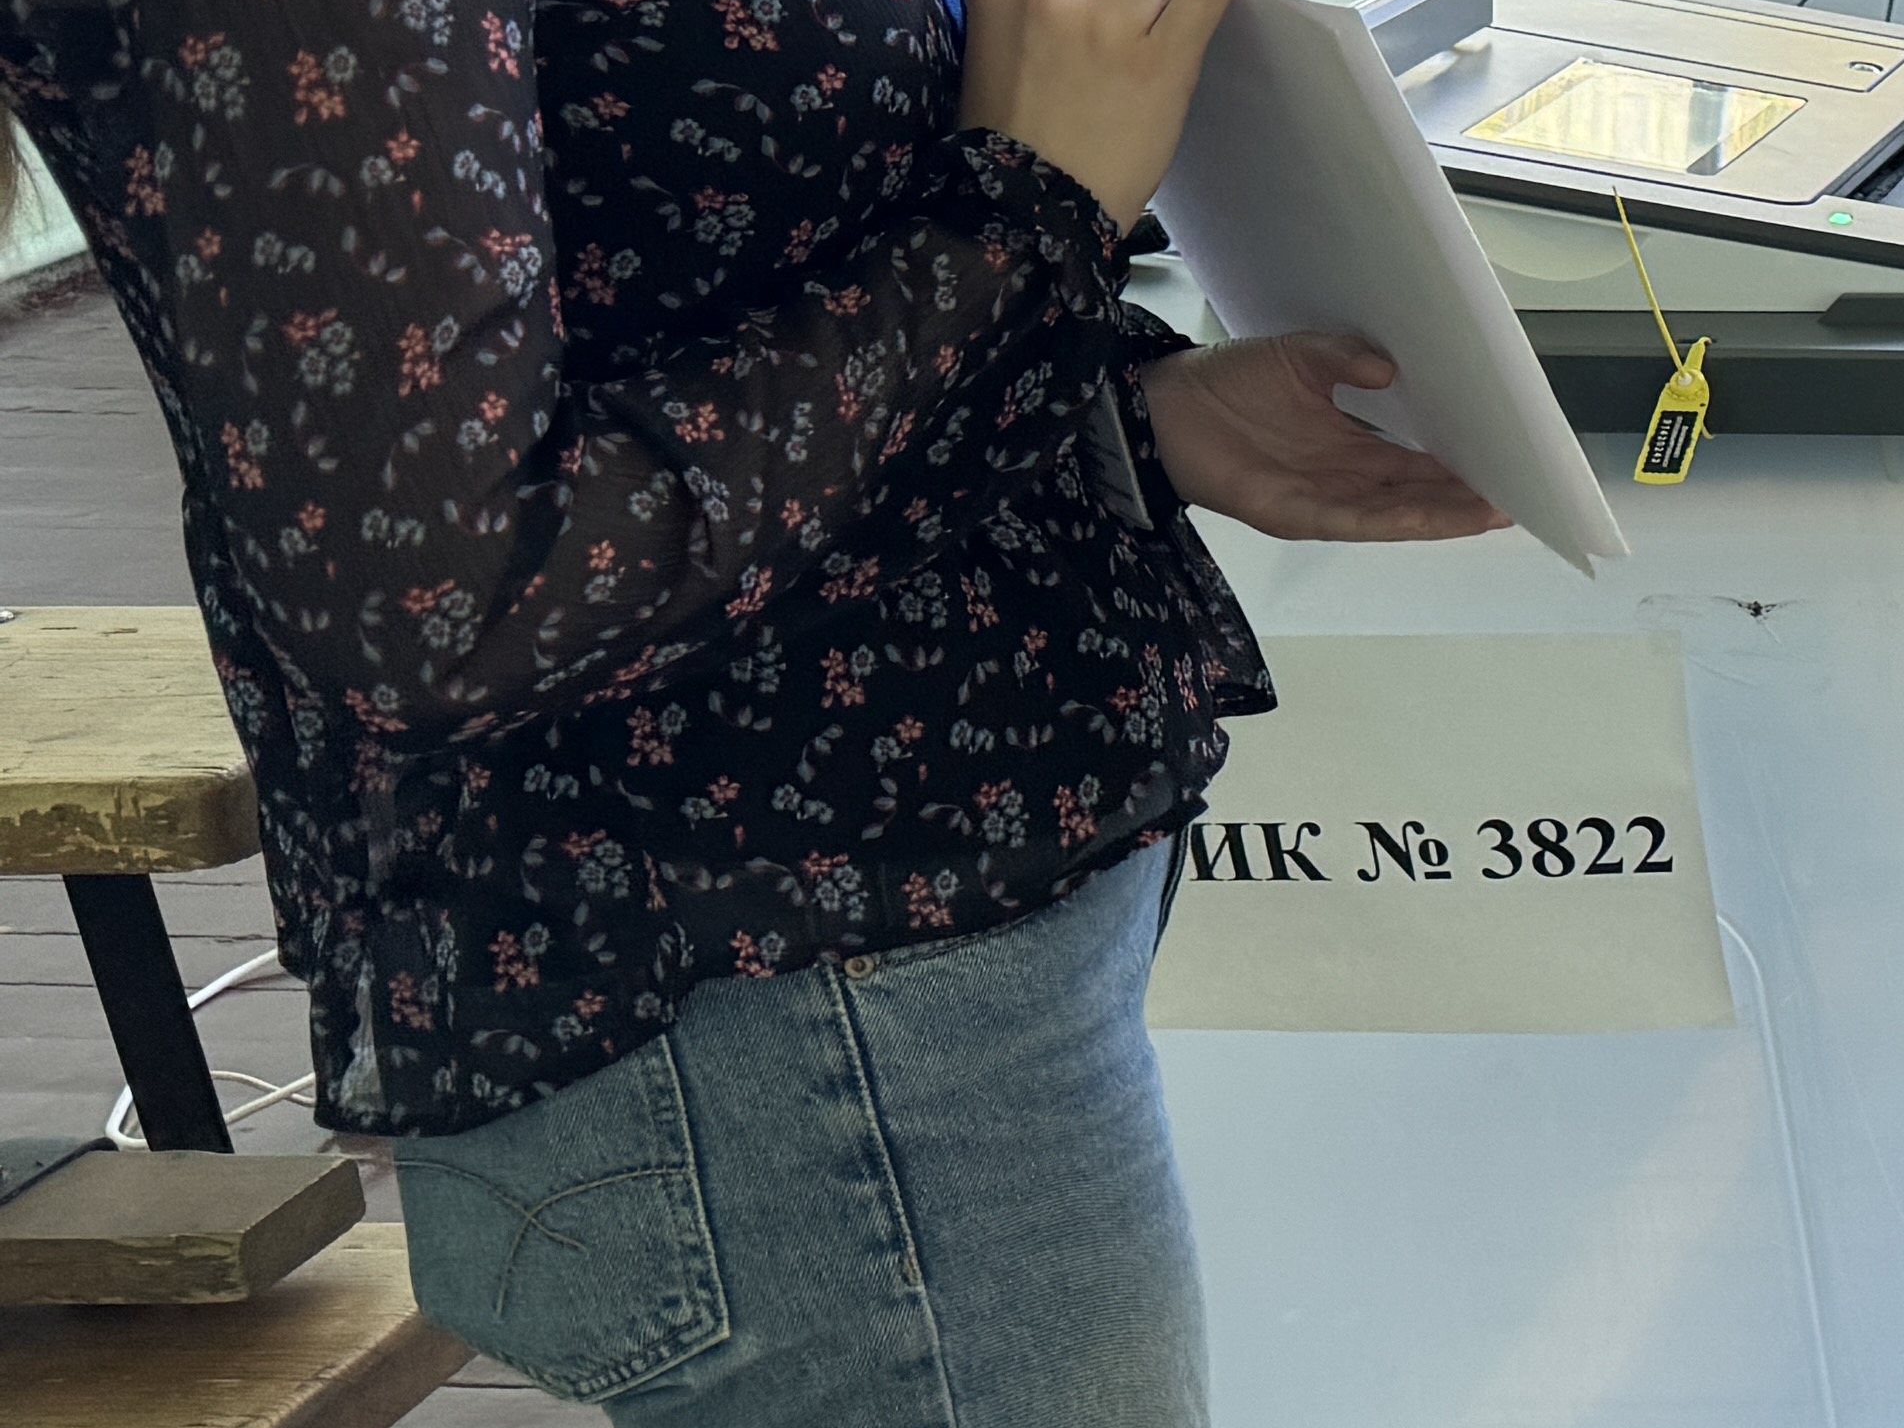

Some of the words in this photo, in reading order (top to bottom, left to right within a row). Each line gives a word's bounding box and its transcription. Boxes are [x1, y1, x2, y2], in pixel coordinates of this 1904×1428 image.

[1188, 822, 1332, 883] ИК
[1355, 820, 1452, 882] №
[1476, 815, 1674, 881] 3822
